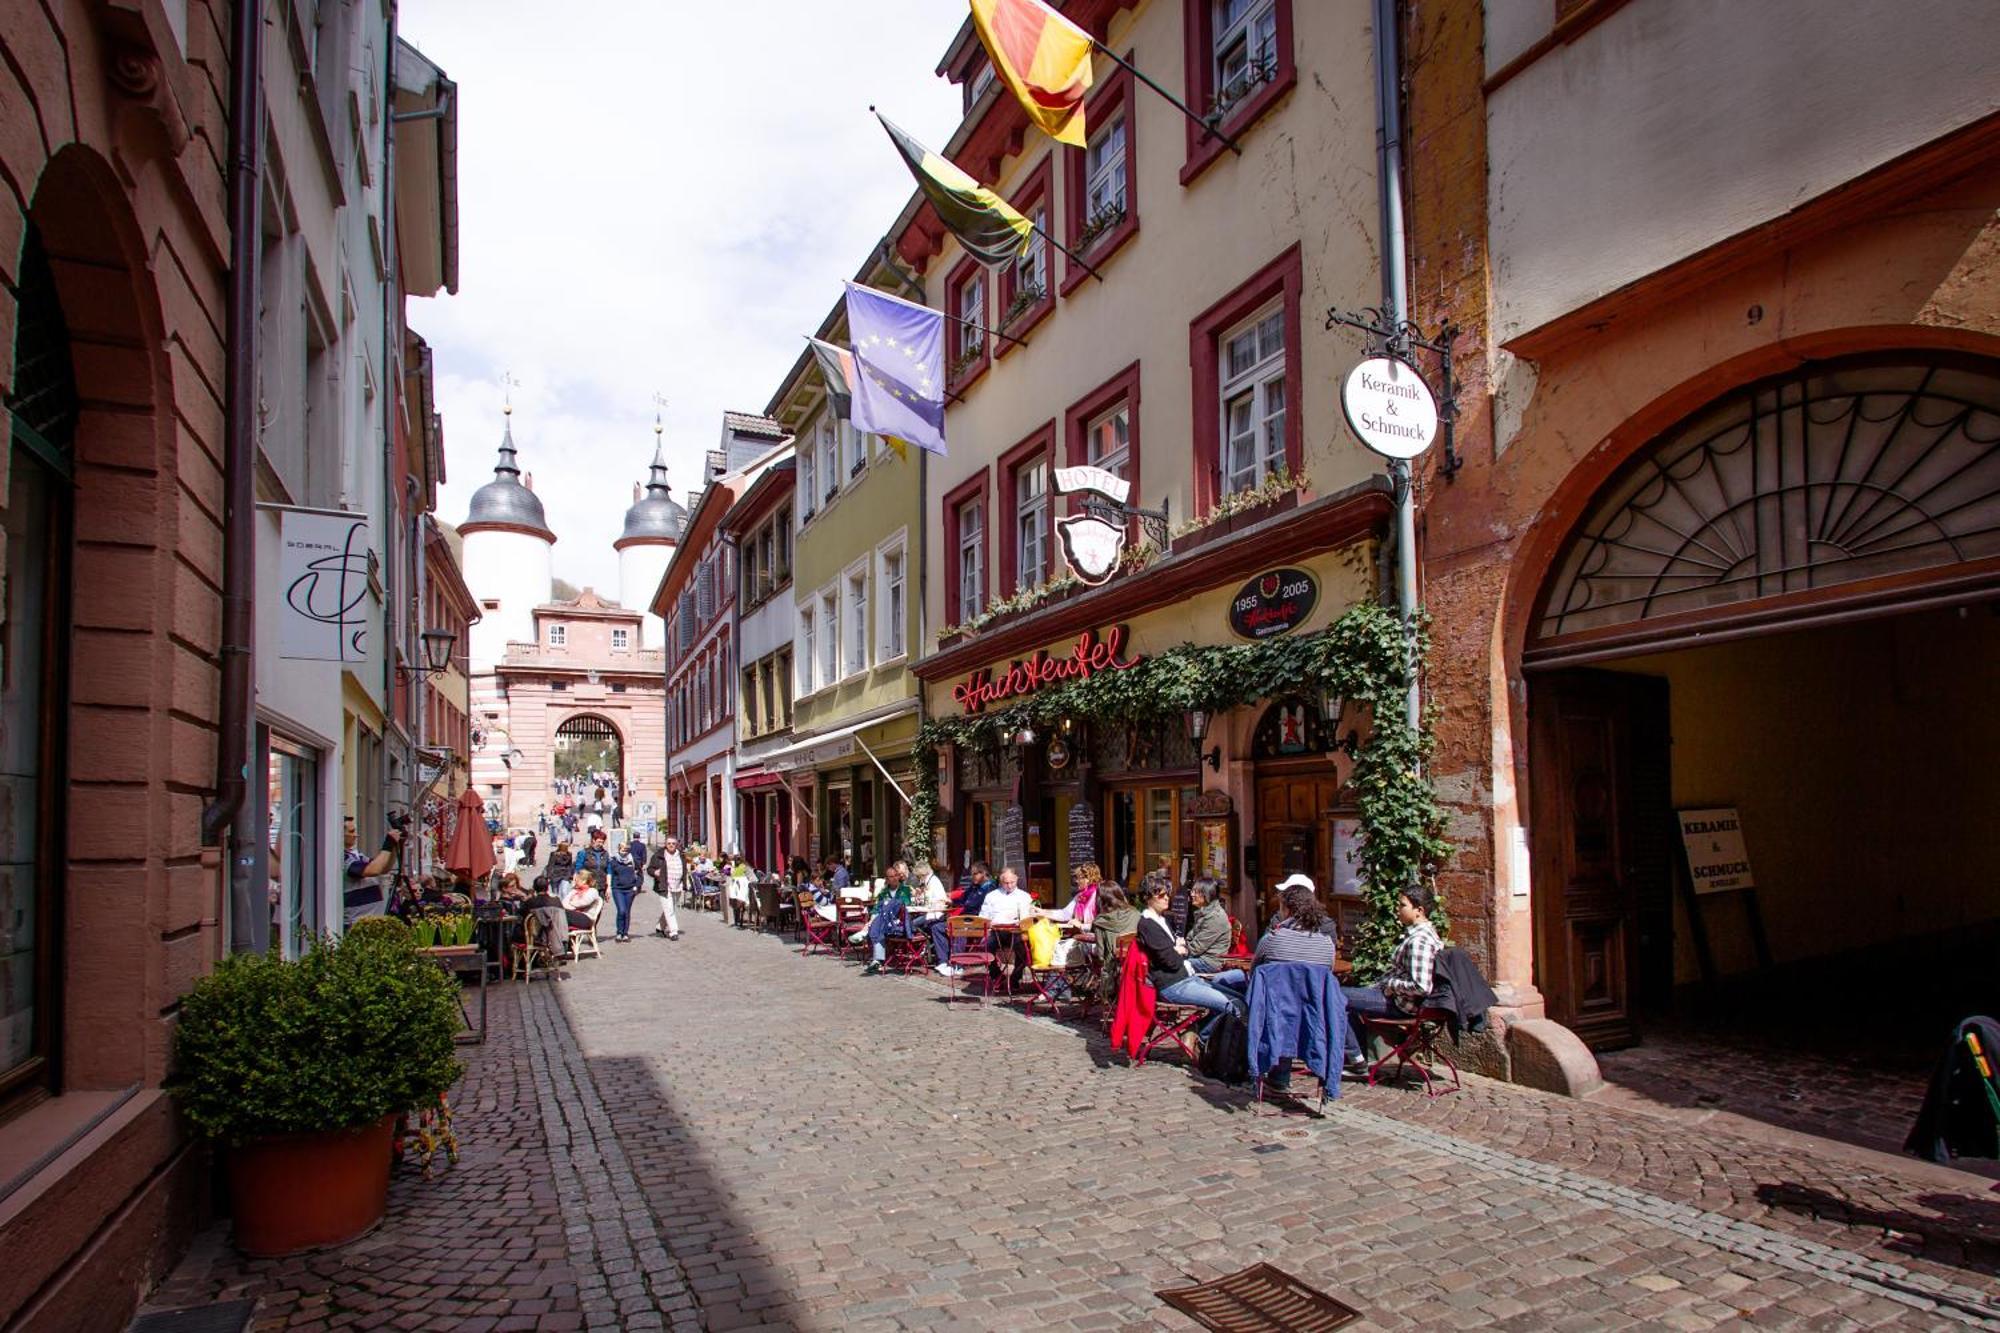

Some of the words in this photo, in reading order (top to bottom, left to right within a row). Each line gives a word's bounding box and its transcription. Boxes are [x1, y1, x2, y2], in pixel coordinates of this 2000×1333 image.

[1747, 304, 1763, 326] 9
[1361, 372, 1421, 401] Keramik
[1386, 399, 1399, 416] &
[1361, 412, 1425, 441] Schmuck
[1058, 468, 1124, 499] HOTEL
[1235, 596, 1257, 612] 1955
[1282, 580, 1309, 598] 2005
[952, 626, 1141, 711] Hackteufel
[1684, 819, 1738, 835] KERAMIK
[1693, 861, 1749, 879] SCHMUCK
